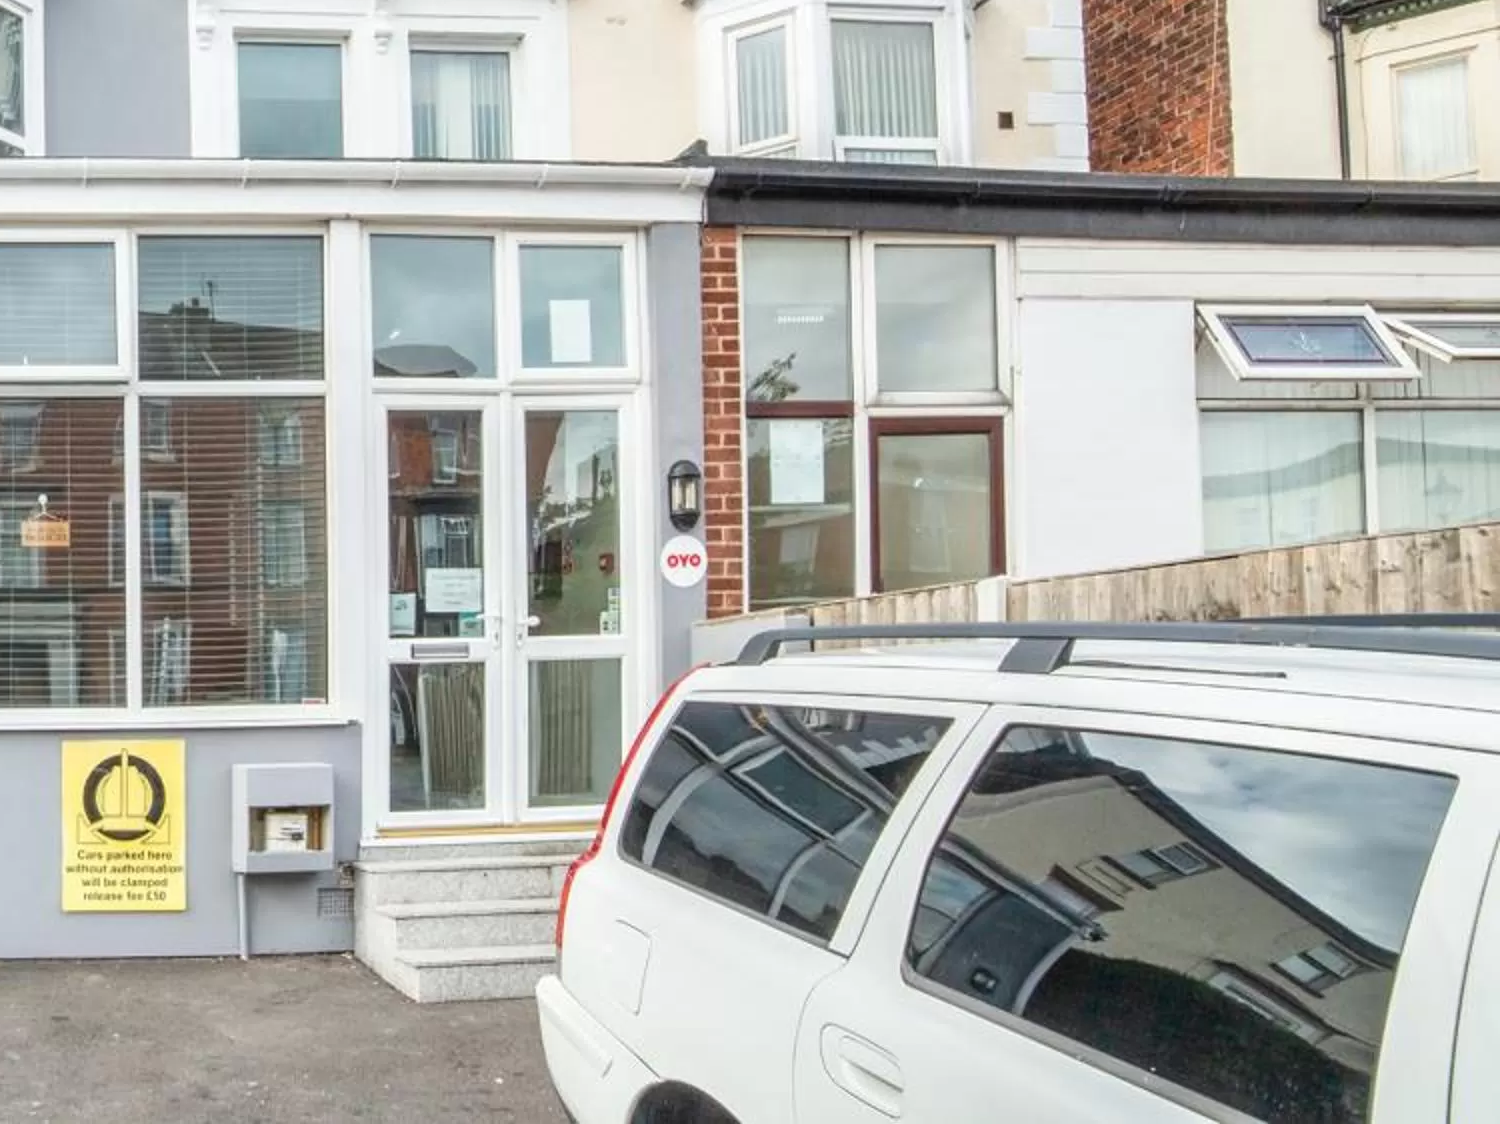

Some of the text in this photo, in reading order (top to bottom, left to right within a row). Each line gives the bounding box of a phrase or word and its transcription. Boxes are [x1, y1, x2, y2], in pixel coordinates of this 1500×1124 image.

[667, 553, 701, 568] OYO
[77, 849, 173, 863] Cars parked here
[65, 863, 184, 874] without authorisation
[82, 877, 168, 888] will be clamped
[83, 891, 123, 901] release
[126, 890, 144, 901] fee
